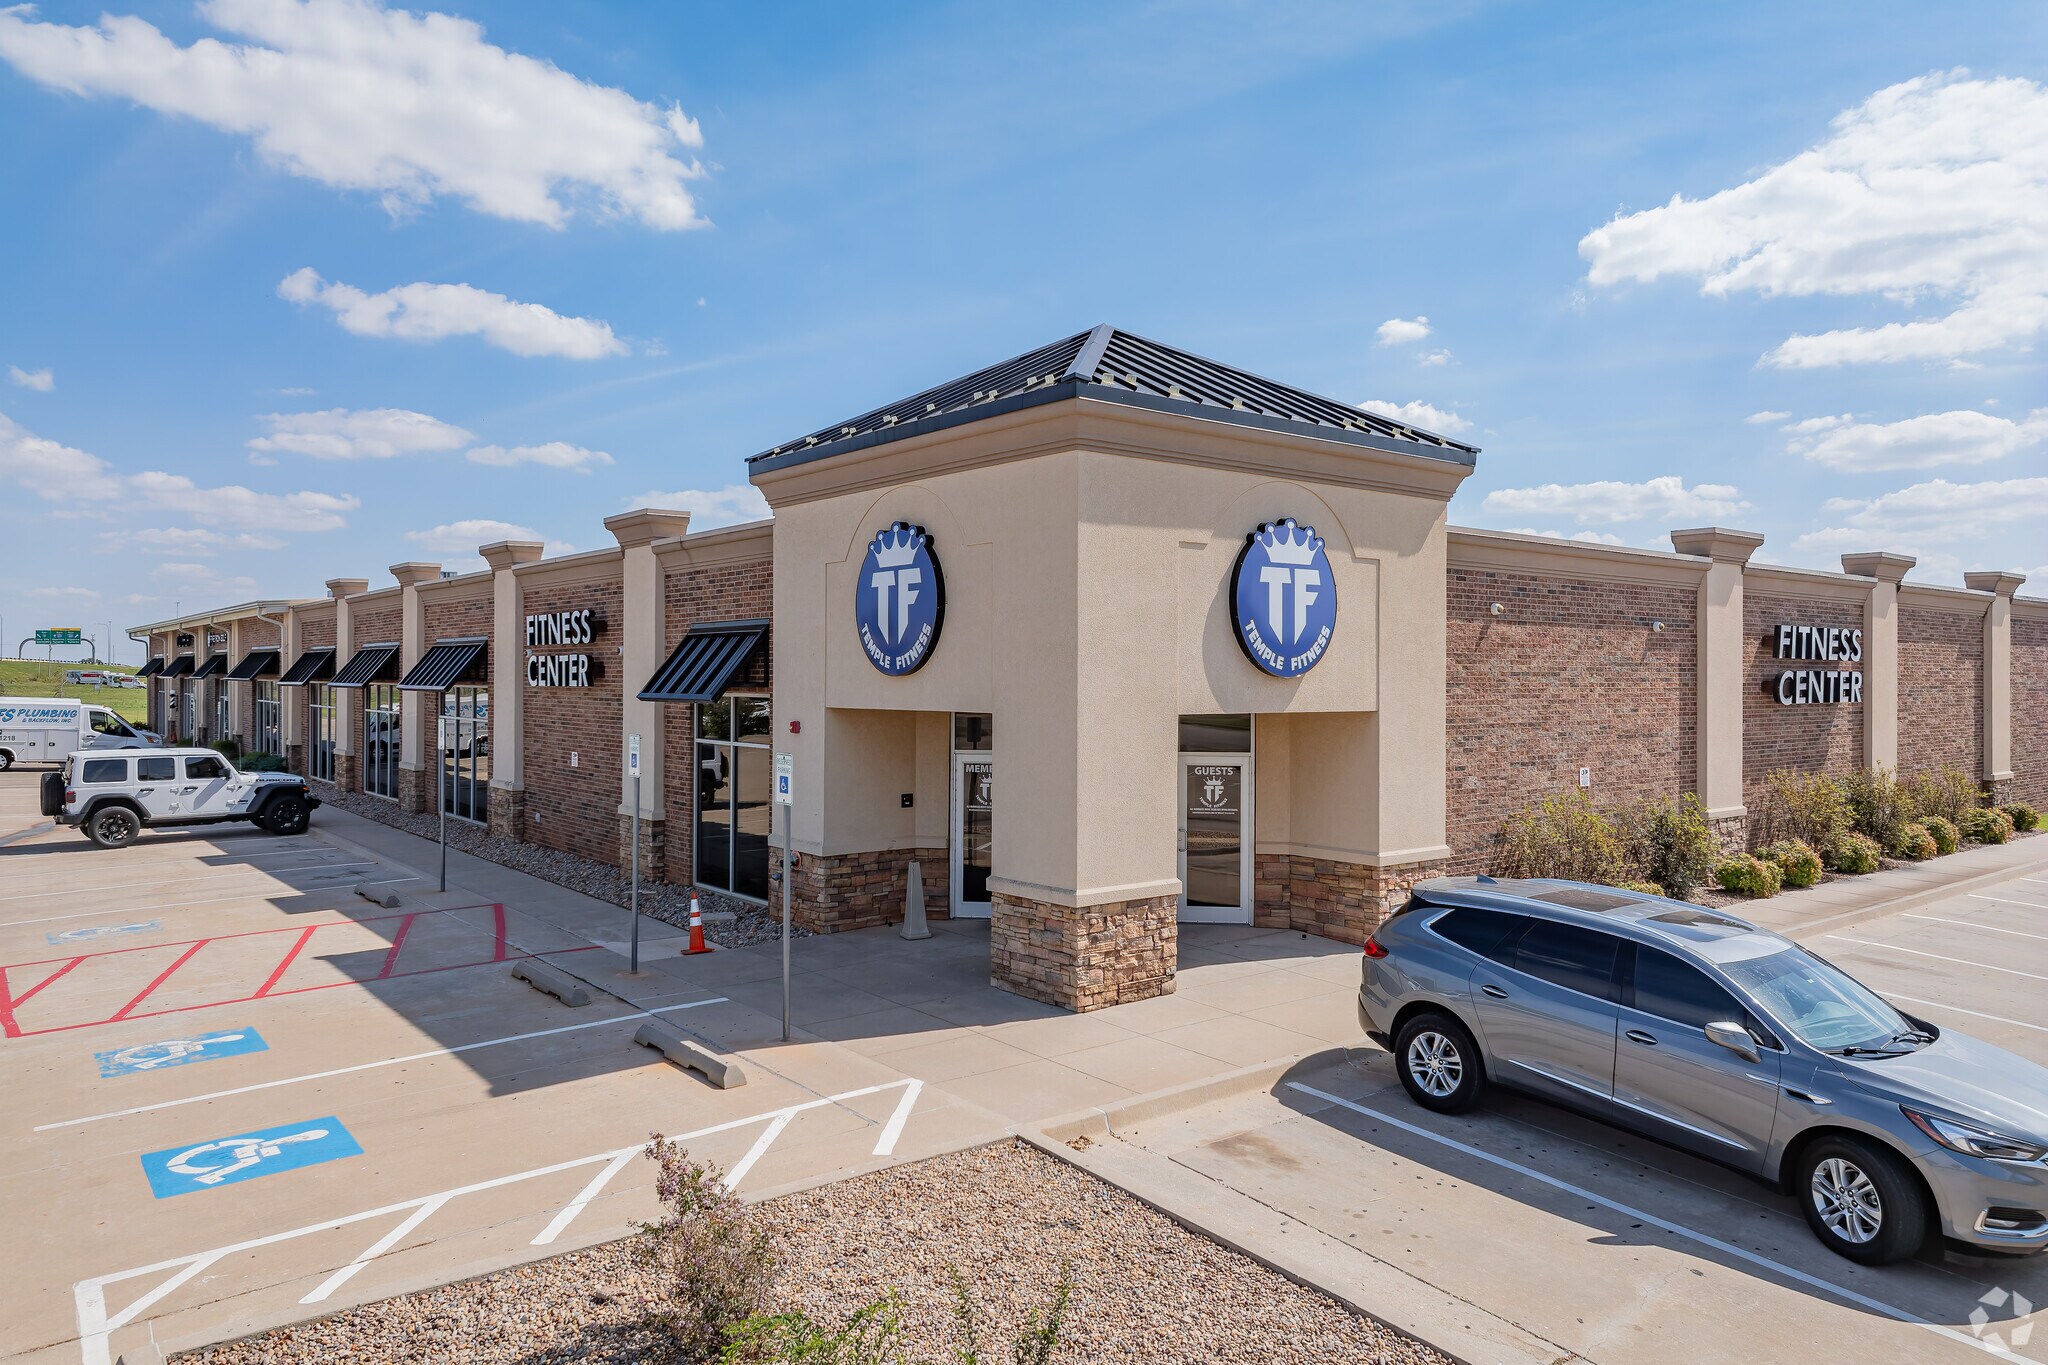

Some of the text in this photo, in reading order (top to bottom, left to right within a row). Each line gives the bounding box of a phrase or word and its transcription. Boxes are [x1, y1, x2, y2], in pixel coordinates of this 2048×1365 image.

[871, 567, 922, 645] TF
[1259, 566, 1321, 645] TF
[526, 609, 591, 646] FITNESS
[1245, 619, 1331, 671] TEMPLE FITNESS
[1779, 625, 1862, 662] FITNESS
[861, 623, 932, 670] TEMPLE FITNESS
[527, 654, 589, 687] CENTER
[1779, 670, 1863, 706] CENTER
[17, 708, 78, 718] PLUMBING
[1194, 766, 1234, 776] GUESTS
[1203, 785, 1225, 803] TF
